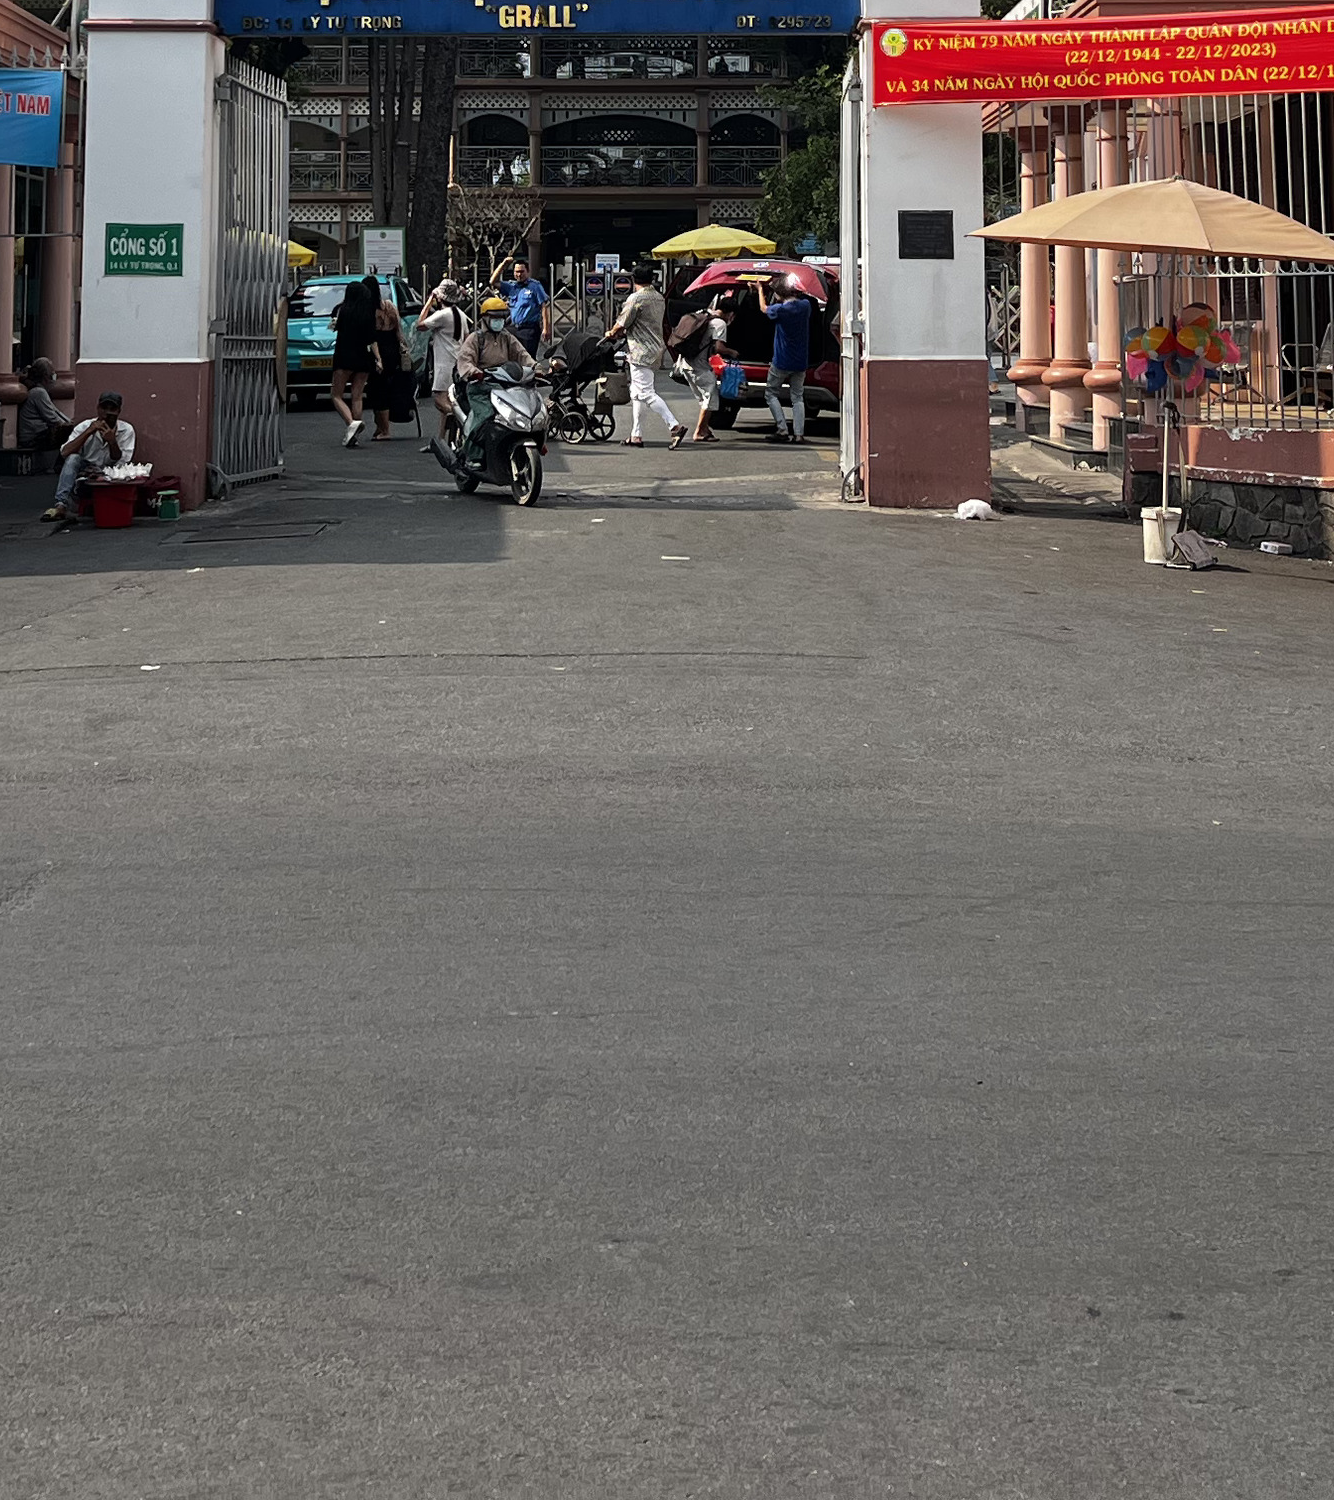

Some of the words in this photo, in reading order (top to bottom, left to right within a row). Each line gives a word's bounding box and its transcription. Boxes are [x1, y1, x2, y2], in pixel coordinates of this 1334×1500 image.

[353, 15, 402, 32] TRỌNG
[938, 32, 975, 52] NIỆM
[980, 34, 998, 49] 79
[1002, 30, 1037, 48] NĂM
[1040, 28, 1085, 46] NGÀY
[1089, 26, 1145, 44] THÀNH
[1149, 24, 1180, 44] LẬP
[1185, 21, 1233, 42] QUÂN
[1237, 20, 1268, 41] ĐỘI
[1272, 16, 1322, 36] NHÂN
[1065, 48, 1161, 66] (22/12/1944
[1175, 42, 1277, 60] 22/12/2023)
[885, 77, 908, 94] VÀ
[911, 78, 930, 93] 34
[933, 74, 968, 92] NĂM
[972, 72, 1017, 91] NGÀY
[1021, 71, 1050, 93] HỘI
[1053, 67, 1101, 90] QUỐC
[1105, 68, 1164, 86] PHÒNG
[1169, 64, 1216, 83] TOÀN
[1220, 63, 1259, 82] DÂN
[16, 93, 51, 116] NAM
[110, 228, 146, 256] CỔNG
[148, 231, 168, 256] SỐ
[171, 237, 178, 256] 1
